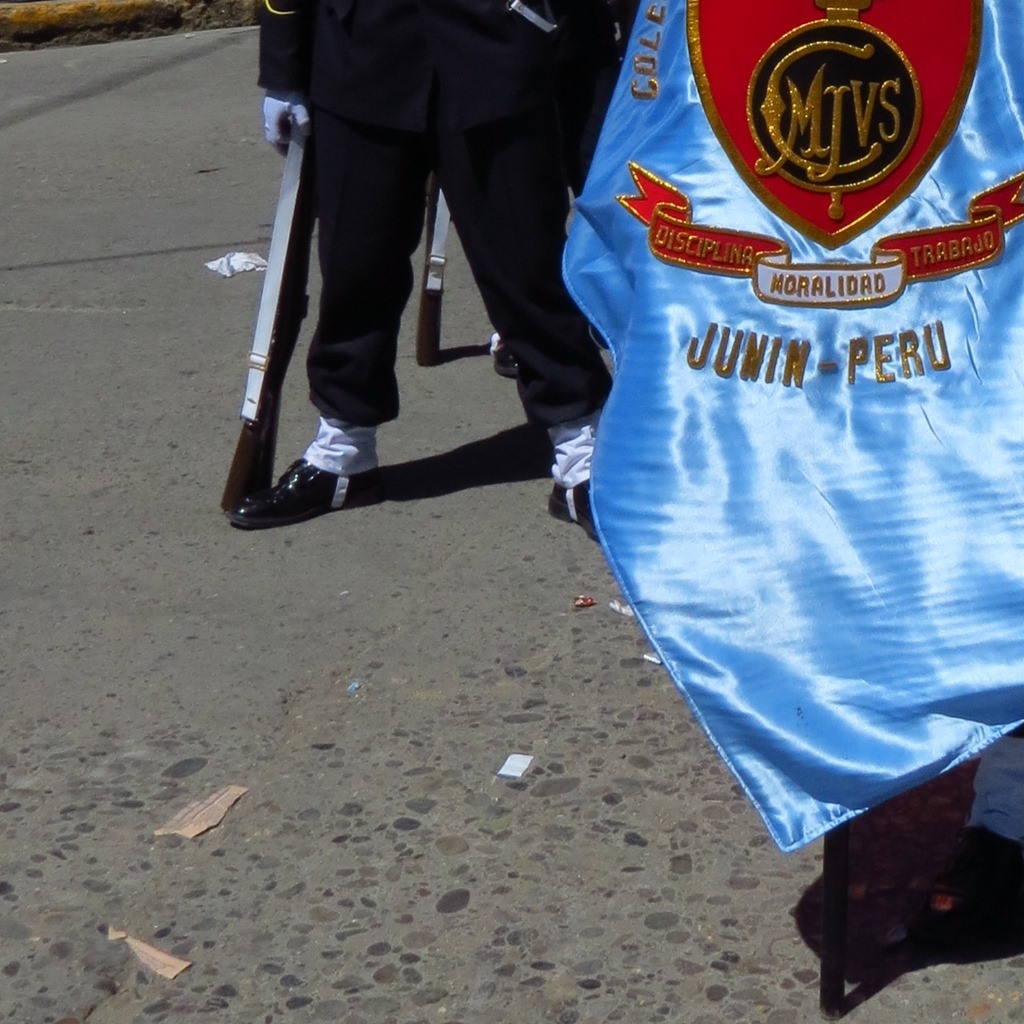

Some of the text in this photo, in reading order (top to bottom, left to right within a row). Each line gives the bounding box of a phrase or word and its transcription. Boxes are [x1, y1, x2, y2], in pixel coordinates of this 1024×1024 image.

[654, 225, 755, 265] DISCIPLINA
[910, 231, 996, 268] TRABAJO
[770, 272, 887, 298] MORALIDAD
